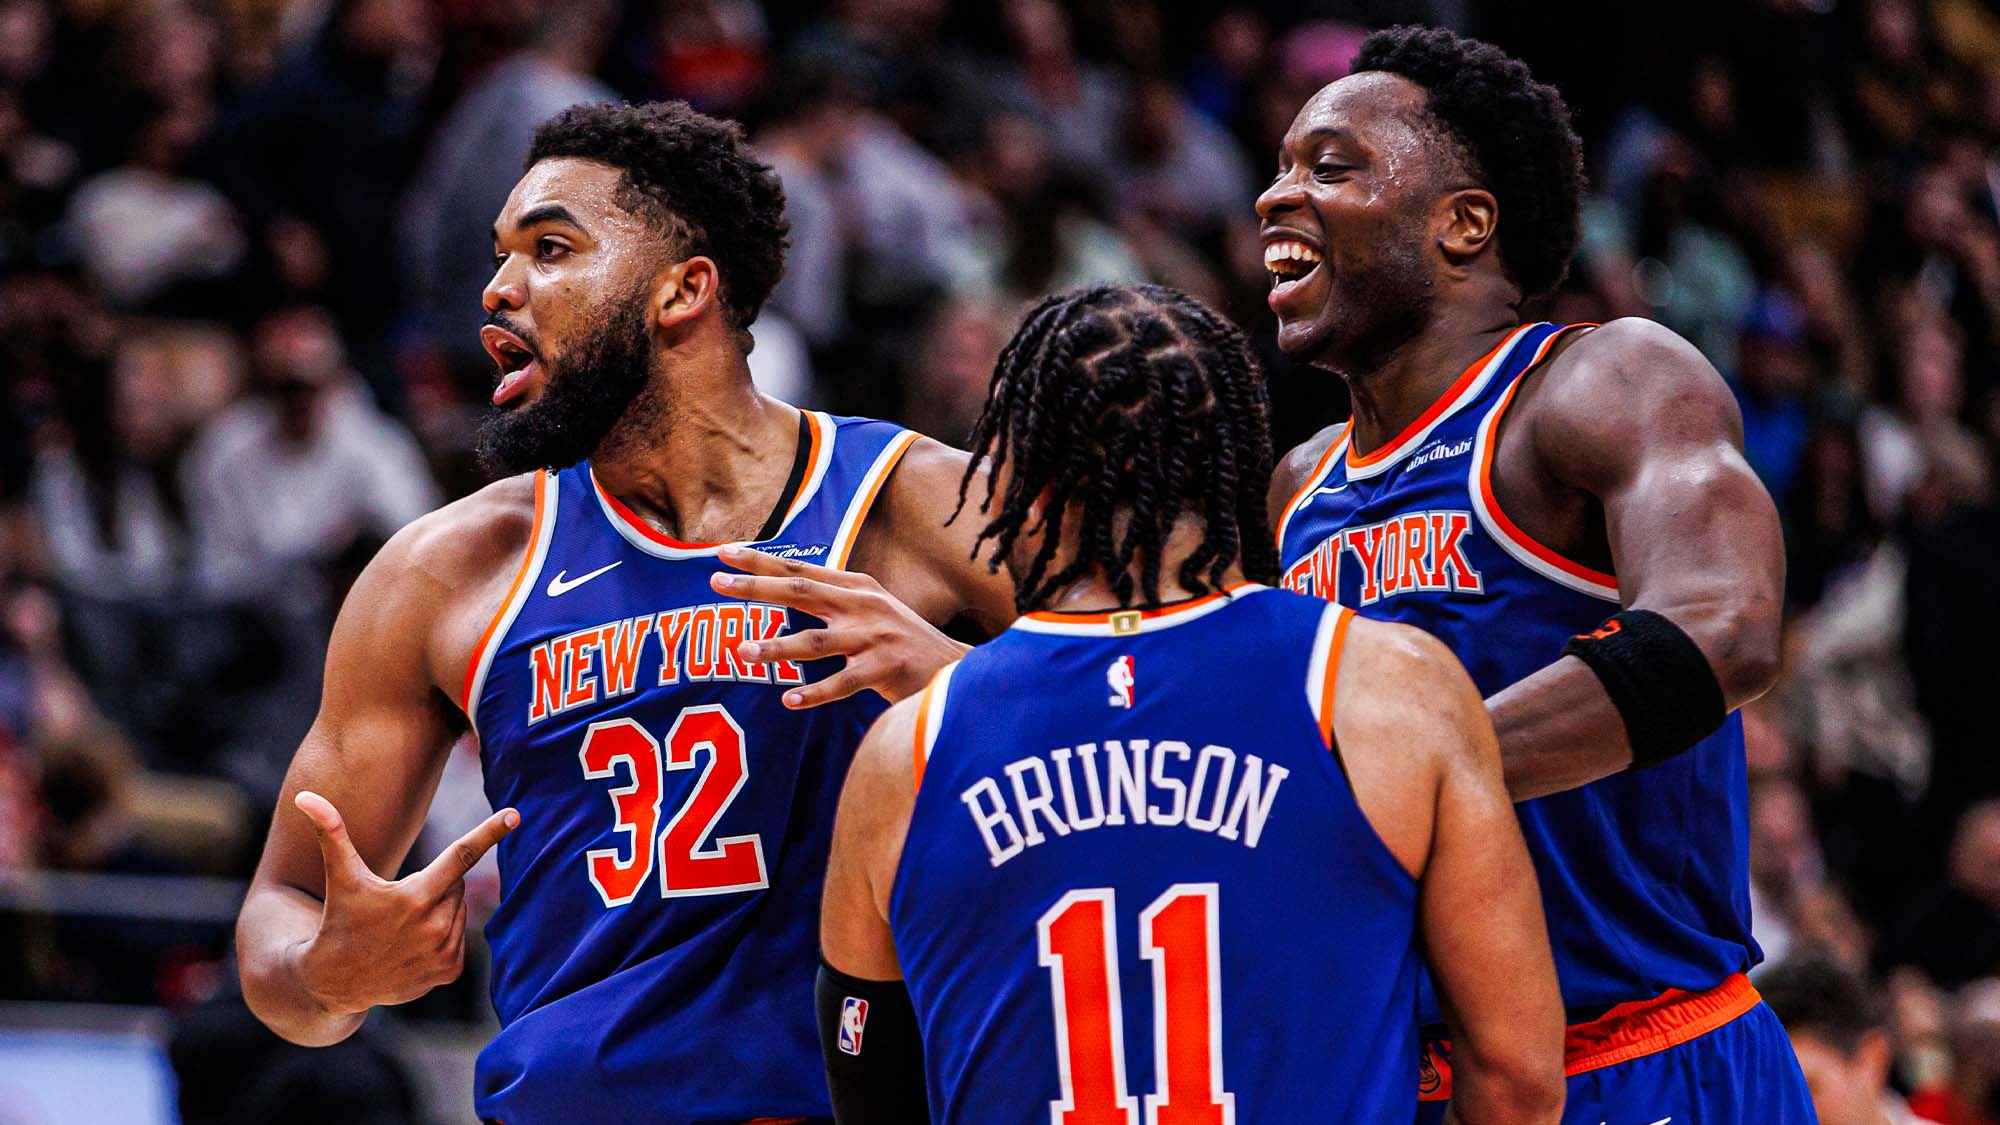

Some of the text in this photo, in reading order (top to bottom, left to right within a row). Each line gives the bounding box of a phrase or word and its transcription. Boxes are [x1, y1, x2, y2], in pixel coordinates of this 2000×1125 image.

[1430, 436, 1473, 461] dhabi
[1280, 510, 1485, 607] EW YORK
[528, 602, 805, 726] NEW YORK
[579, 703, 769, 908] 32
[961, 738, 1289, 867] BRUNSON
[1037, 882, 1236, 1125] 11
